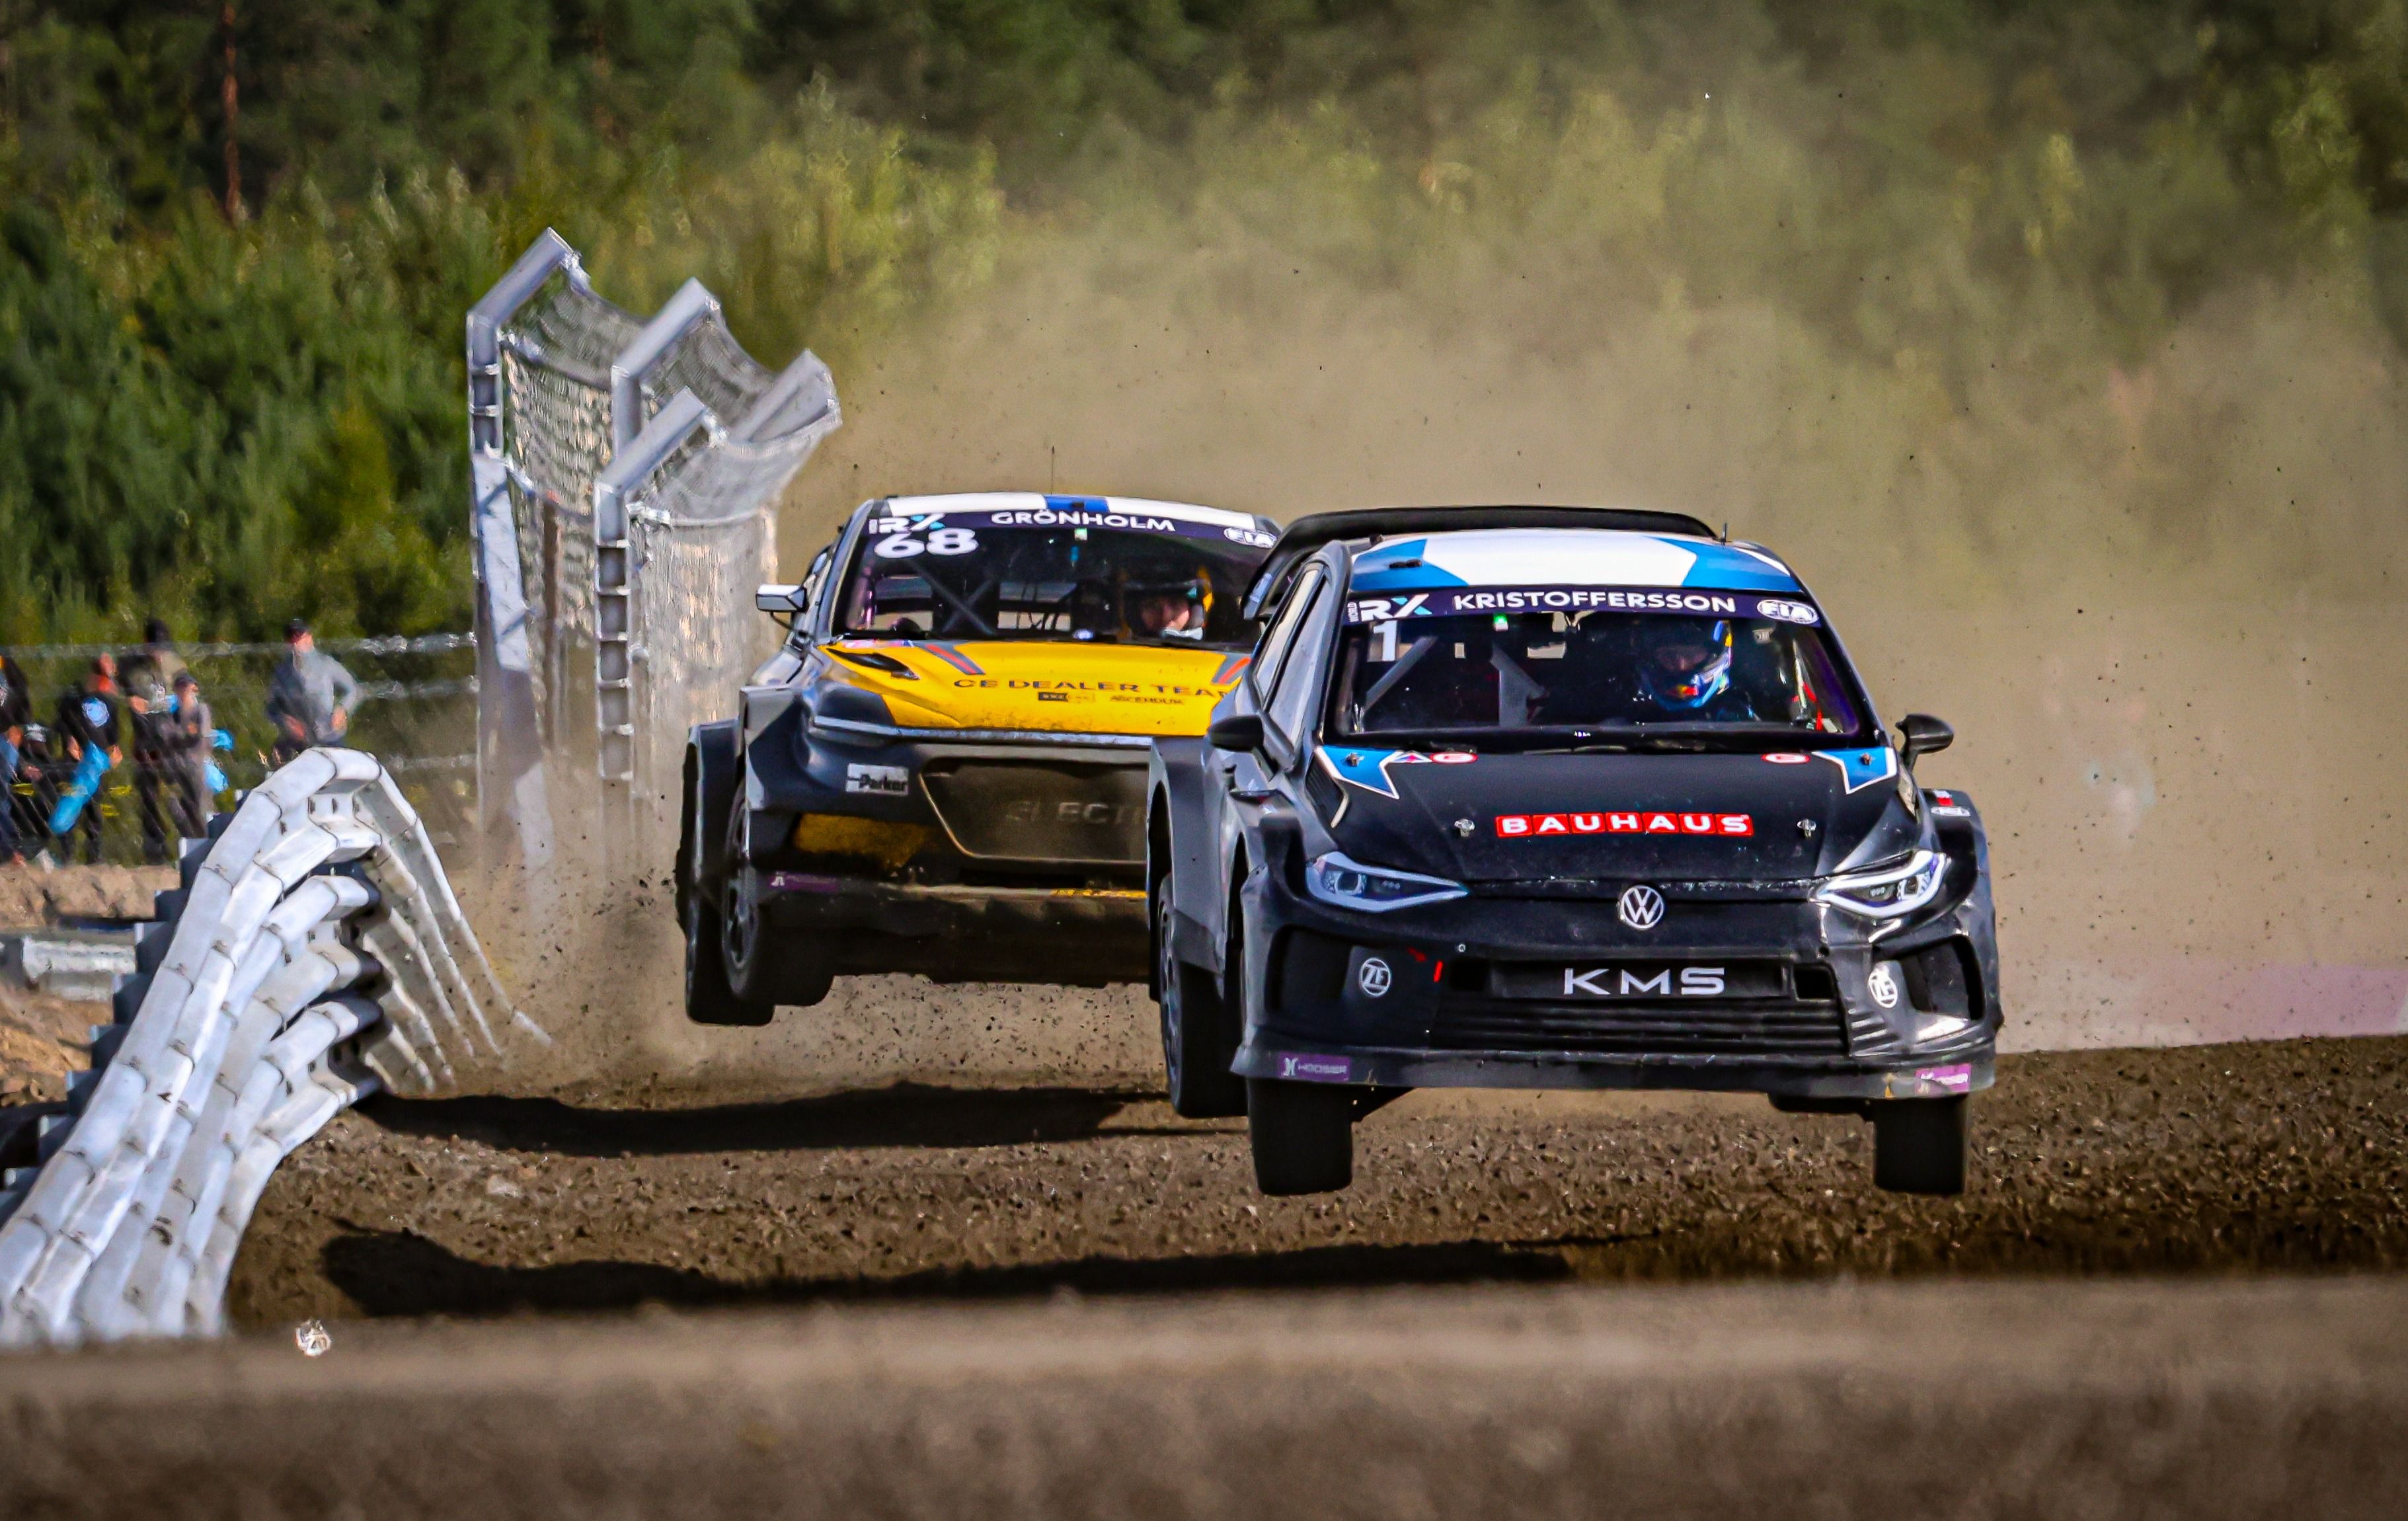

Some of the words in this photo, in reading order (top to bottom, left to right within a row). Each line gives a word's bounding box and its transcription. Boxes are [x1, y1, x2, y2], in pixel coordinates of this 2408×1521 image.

[991, 508, 1176, 531] GRÖNHOLM
[874, 527, 979, 559] 68
[1359, 594, 1433, 622] RX
[1455, 591, 1737, 613] KRISTOFFERSSON
[1759, 600, 1816, 623] FIA
[1374, 620, 1397, 662] 1
[954, 679, 997, 688] CE
[1009, 680, 1139, 692] DEALER
[859, 771, 908, 791] Parker
[1502, 814, 1750, 834] BAUHAUS
[1360, 960, 1391, 994] ZF
[1563, 966, 1725, 995] KMS
